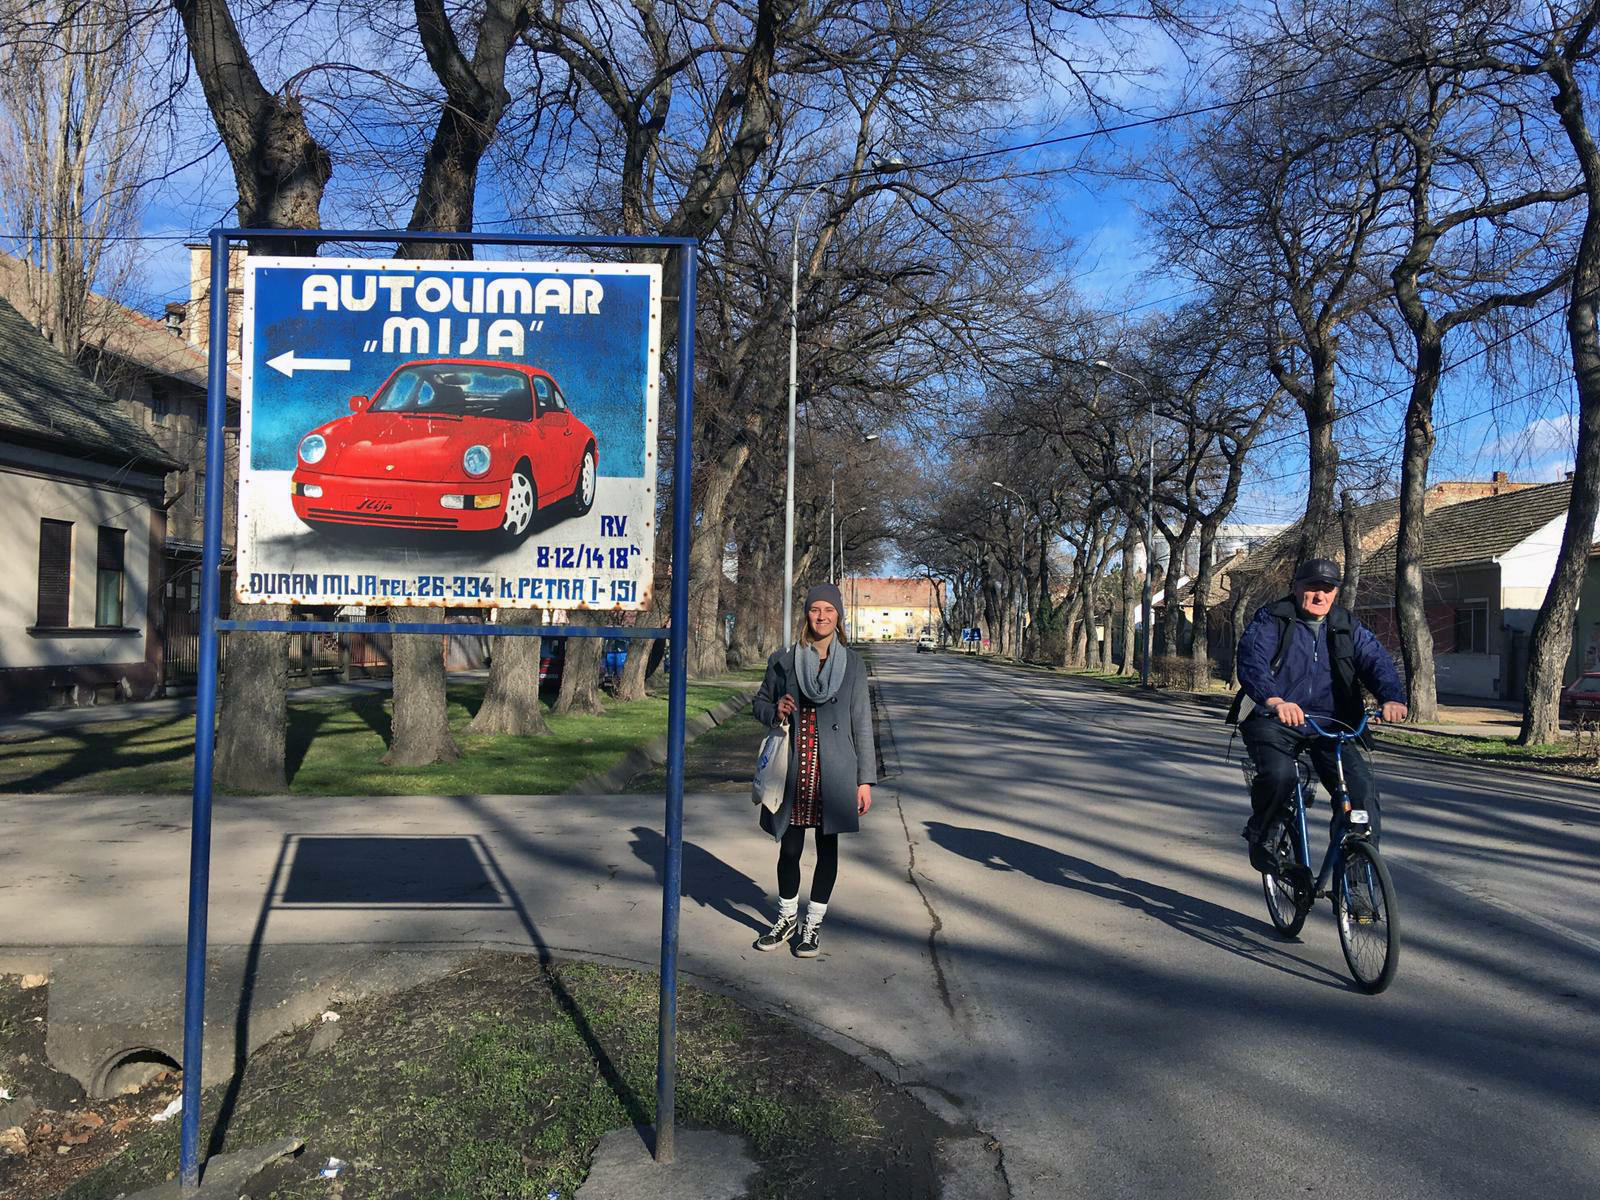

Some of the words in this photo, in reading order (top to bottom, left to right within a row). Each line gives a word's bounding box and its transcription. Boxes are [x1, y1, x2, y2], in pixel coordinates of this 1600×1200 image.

[302, 274, 604, 315] AUTOLIMAR
[600, 515, 627, 537] R.V.
[250, 573, 318, 595] ĐURAN
[323, 574, 377, 596] MIJA
